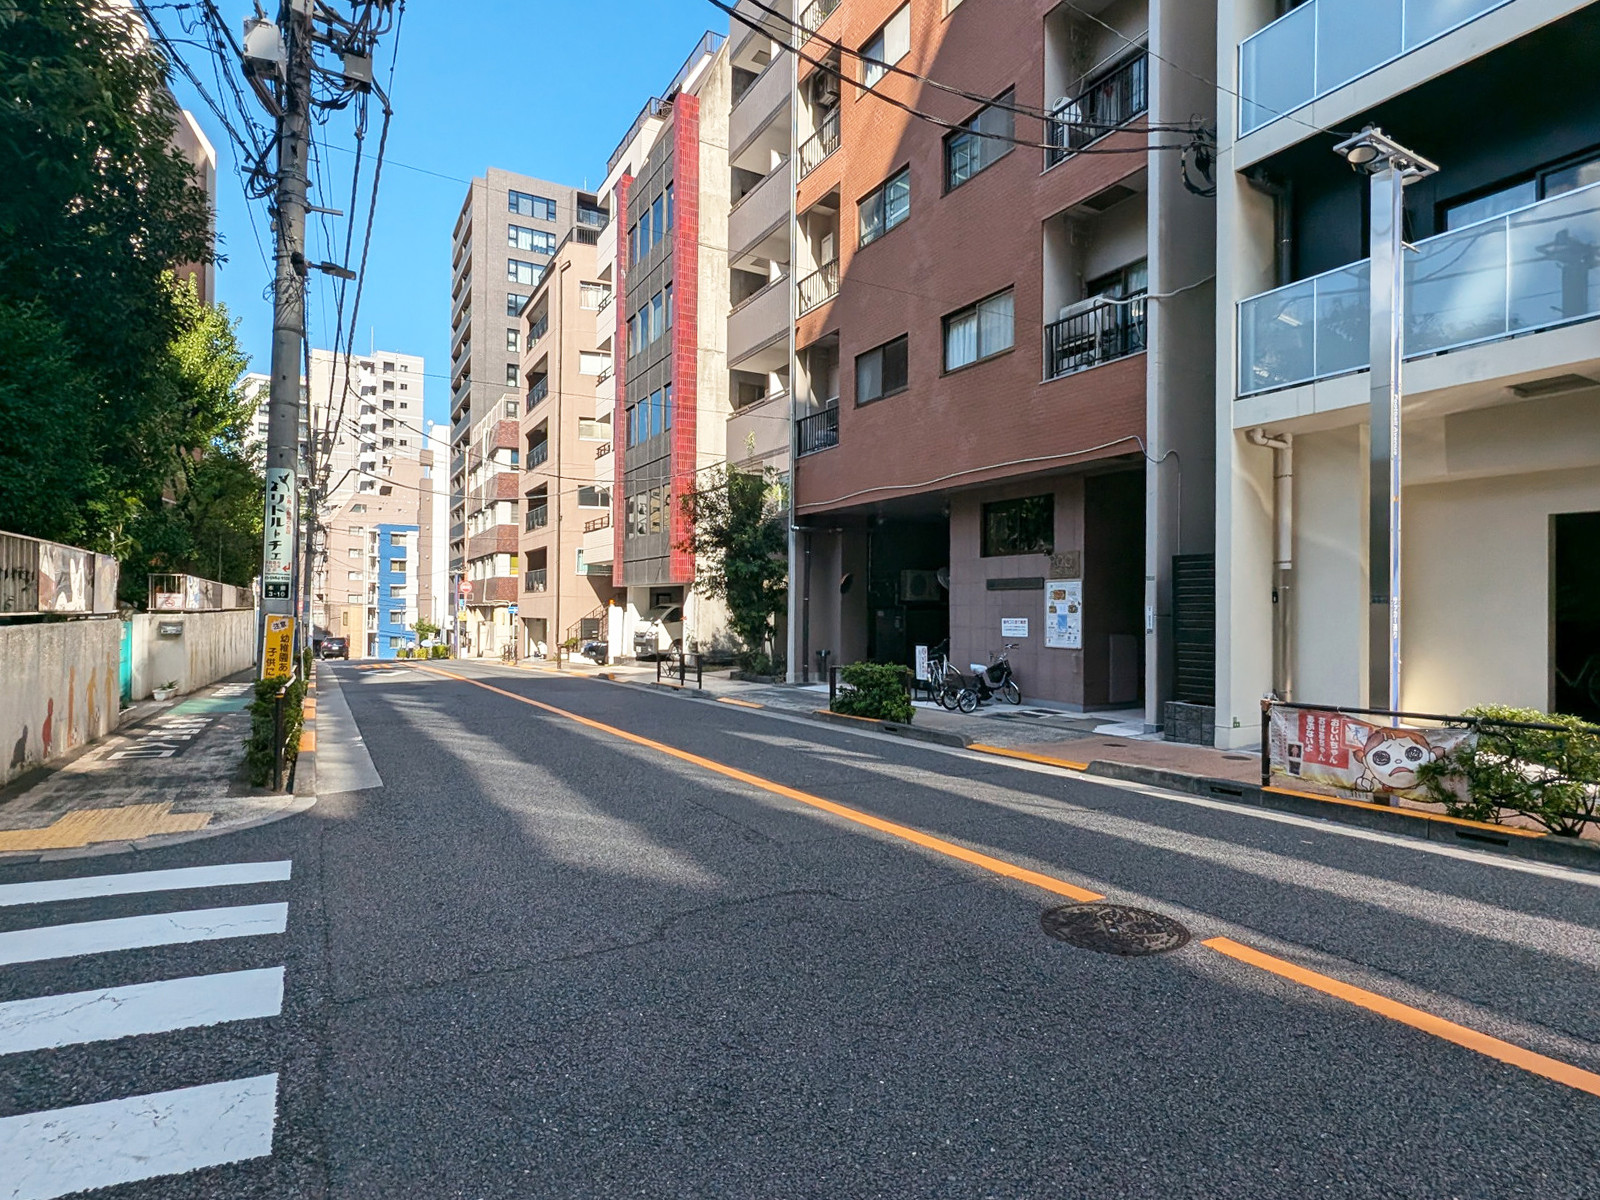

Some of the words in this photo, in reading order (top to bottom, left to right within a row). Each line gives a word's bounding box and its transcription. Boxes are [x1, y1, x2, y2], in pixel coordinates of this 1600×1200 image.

[272, 621, 287, 629] 注意
[1304, 715, 1315, 753] あぶないよ
[1329, 718, 1340, 765] おじいちゃん
